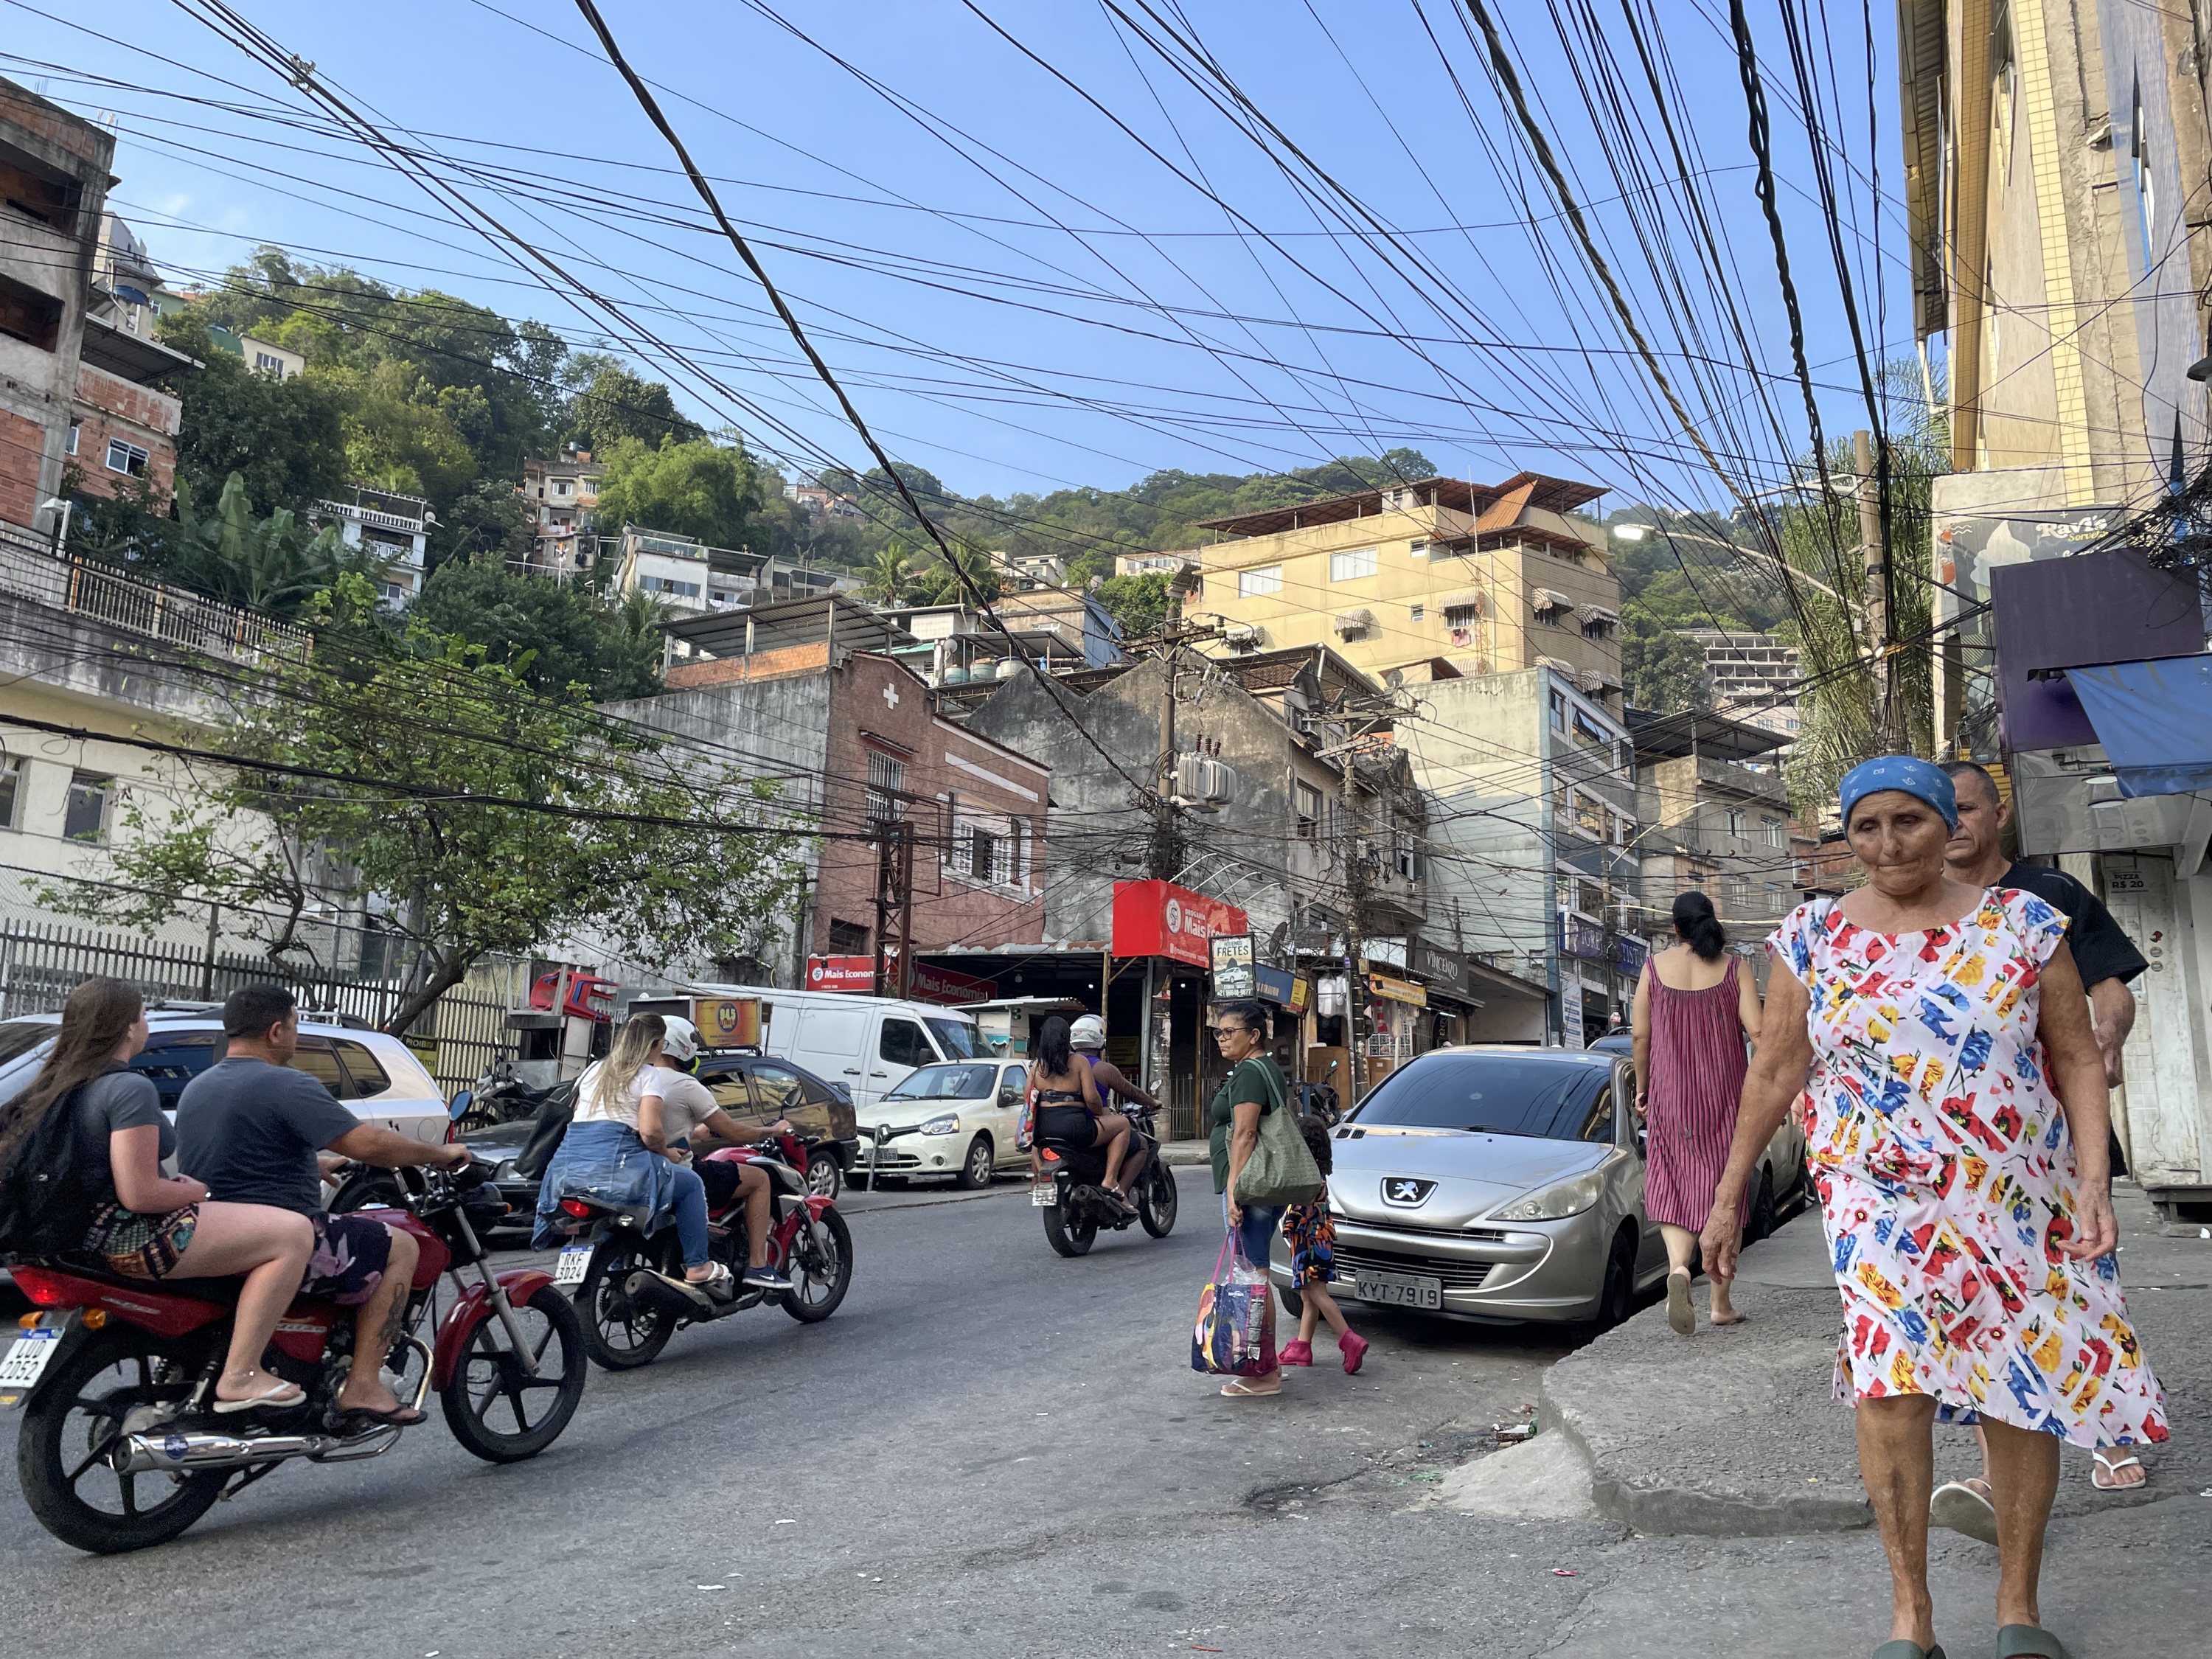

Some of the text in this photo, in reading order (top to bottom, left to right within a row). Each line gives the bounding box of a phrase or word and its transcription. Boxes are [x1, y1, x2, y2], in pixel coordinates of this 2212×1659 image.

[2112, 880, 2127, 888] R$
[1184, 908, 1206, 921] DROGARIA
[1183, 916, 1206, 939] Mais
[1217, 945, 1249, 957] FRETES
[824, 970, 874, 978] Mais Econom
[918, 973, 985, 1001] Mais Economia
[564, 1252, 584, 1266] RKF
[557, 1266, 582, 1280] 3D24
